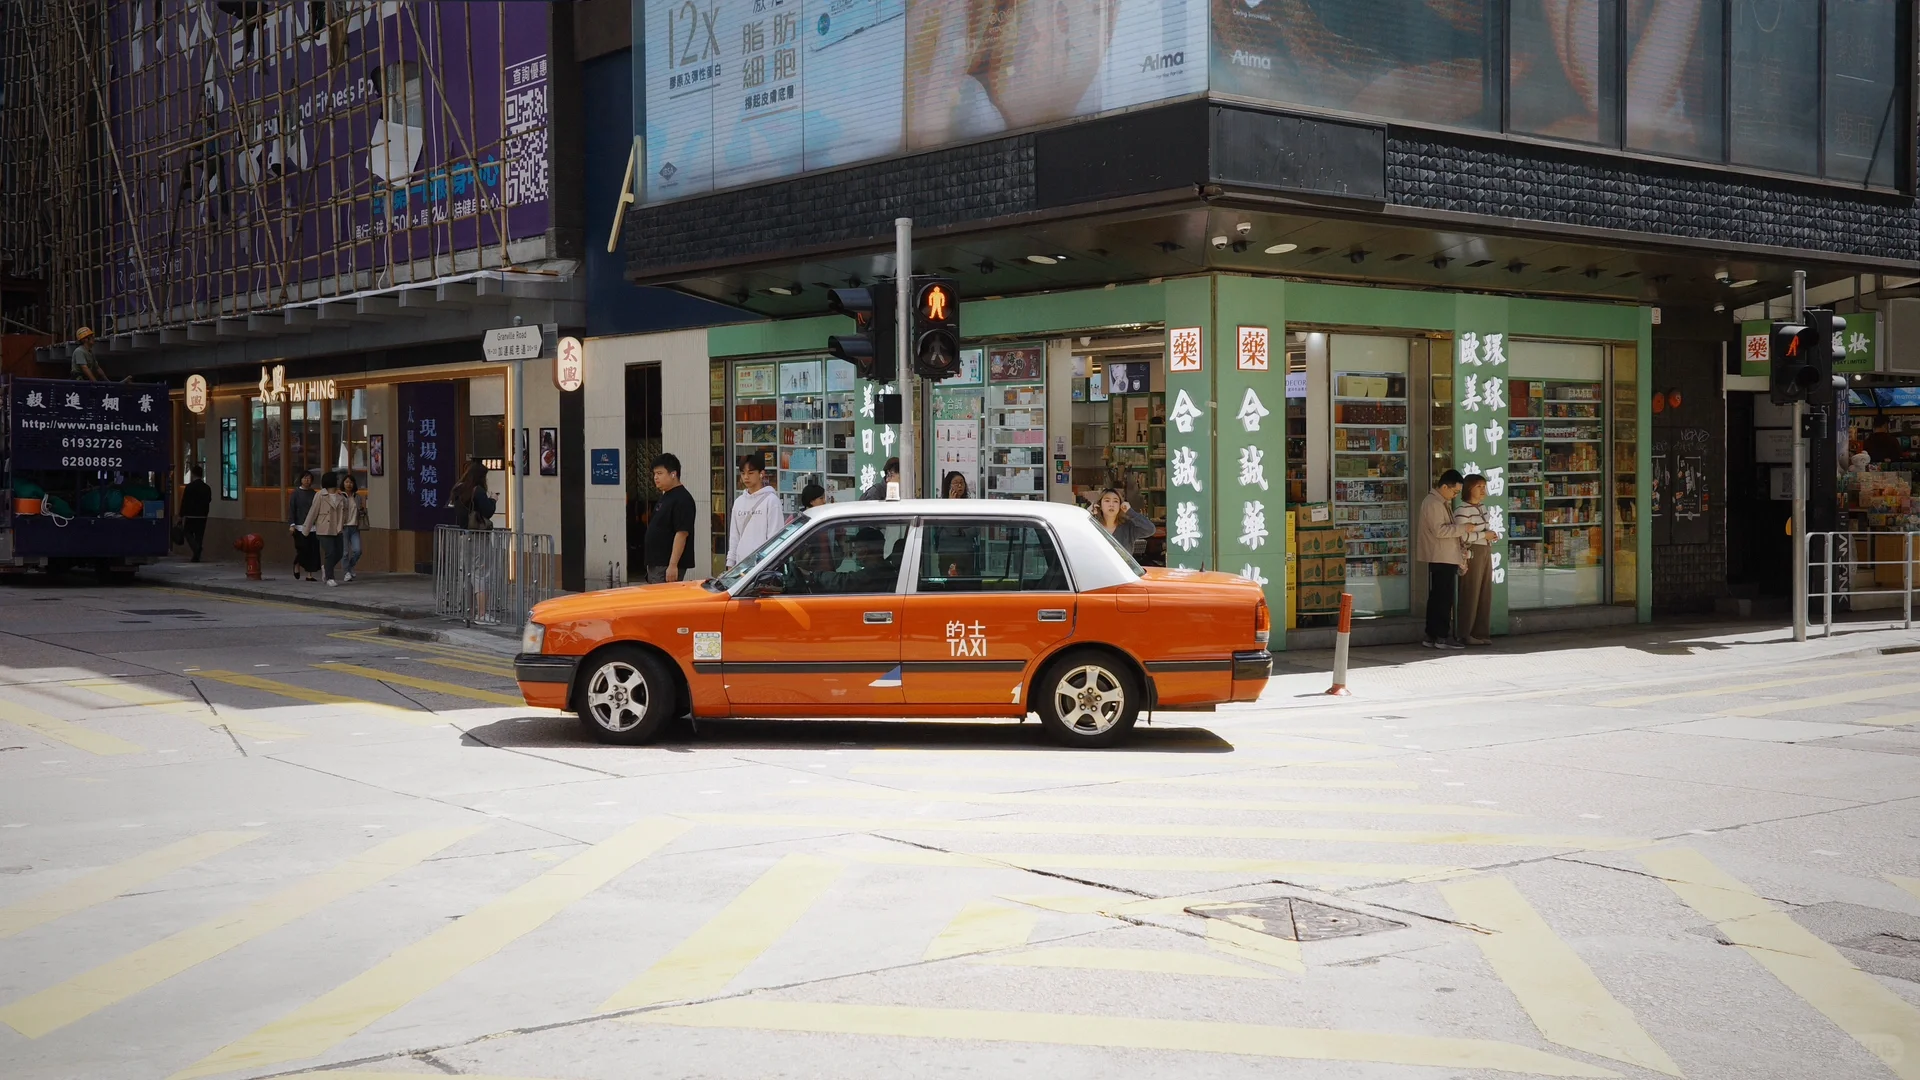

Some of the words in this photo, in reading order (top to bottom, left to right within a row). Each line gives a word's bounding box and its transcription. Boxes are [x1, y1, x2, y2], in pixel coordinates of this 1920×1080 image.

[668, 0, 721, 70] 12X
[742, 11, 797, 56] 脂肪
[742, 48, 797, 89] 細胞
[1138, 51, 1185, 73] Alma
[1230, 49, 1271, 70] Alma
[512, 59, 547, 85] 查詢優惠
[497, 331, 515, 341] Granville
[516, 330, 527, 339] Road
[1748, 336, 1768, 359] 藥
[1173, 331, 1197, 366] 藥
[1242, 331, 1266, 366] 藥
[561, 341, 580, 388] 太興
[189, 377, 204, 410] 太興
[259, 364, 287, 404] 太興
[288, 382, 305, 402] TAI
[309, 379, 336, 400] HING
[26, 390, 154, 413] 毅進棚業
[22, 418, 159, 432] http://www.ngaichun.hk
[62, 438, 123, 449] 61932726
[62, 456, 123, 467] 62808852
[419, 418, 438, 508] 現場燒製
[1170, 388, 1203, 571] 合誠藥
[946, 619, 986, 638] 的士
[946, 638, 987, 657] TAXI
